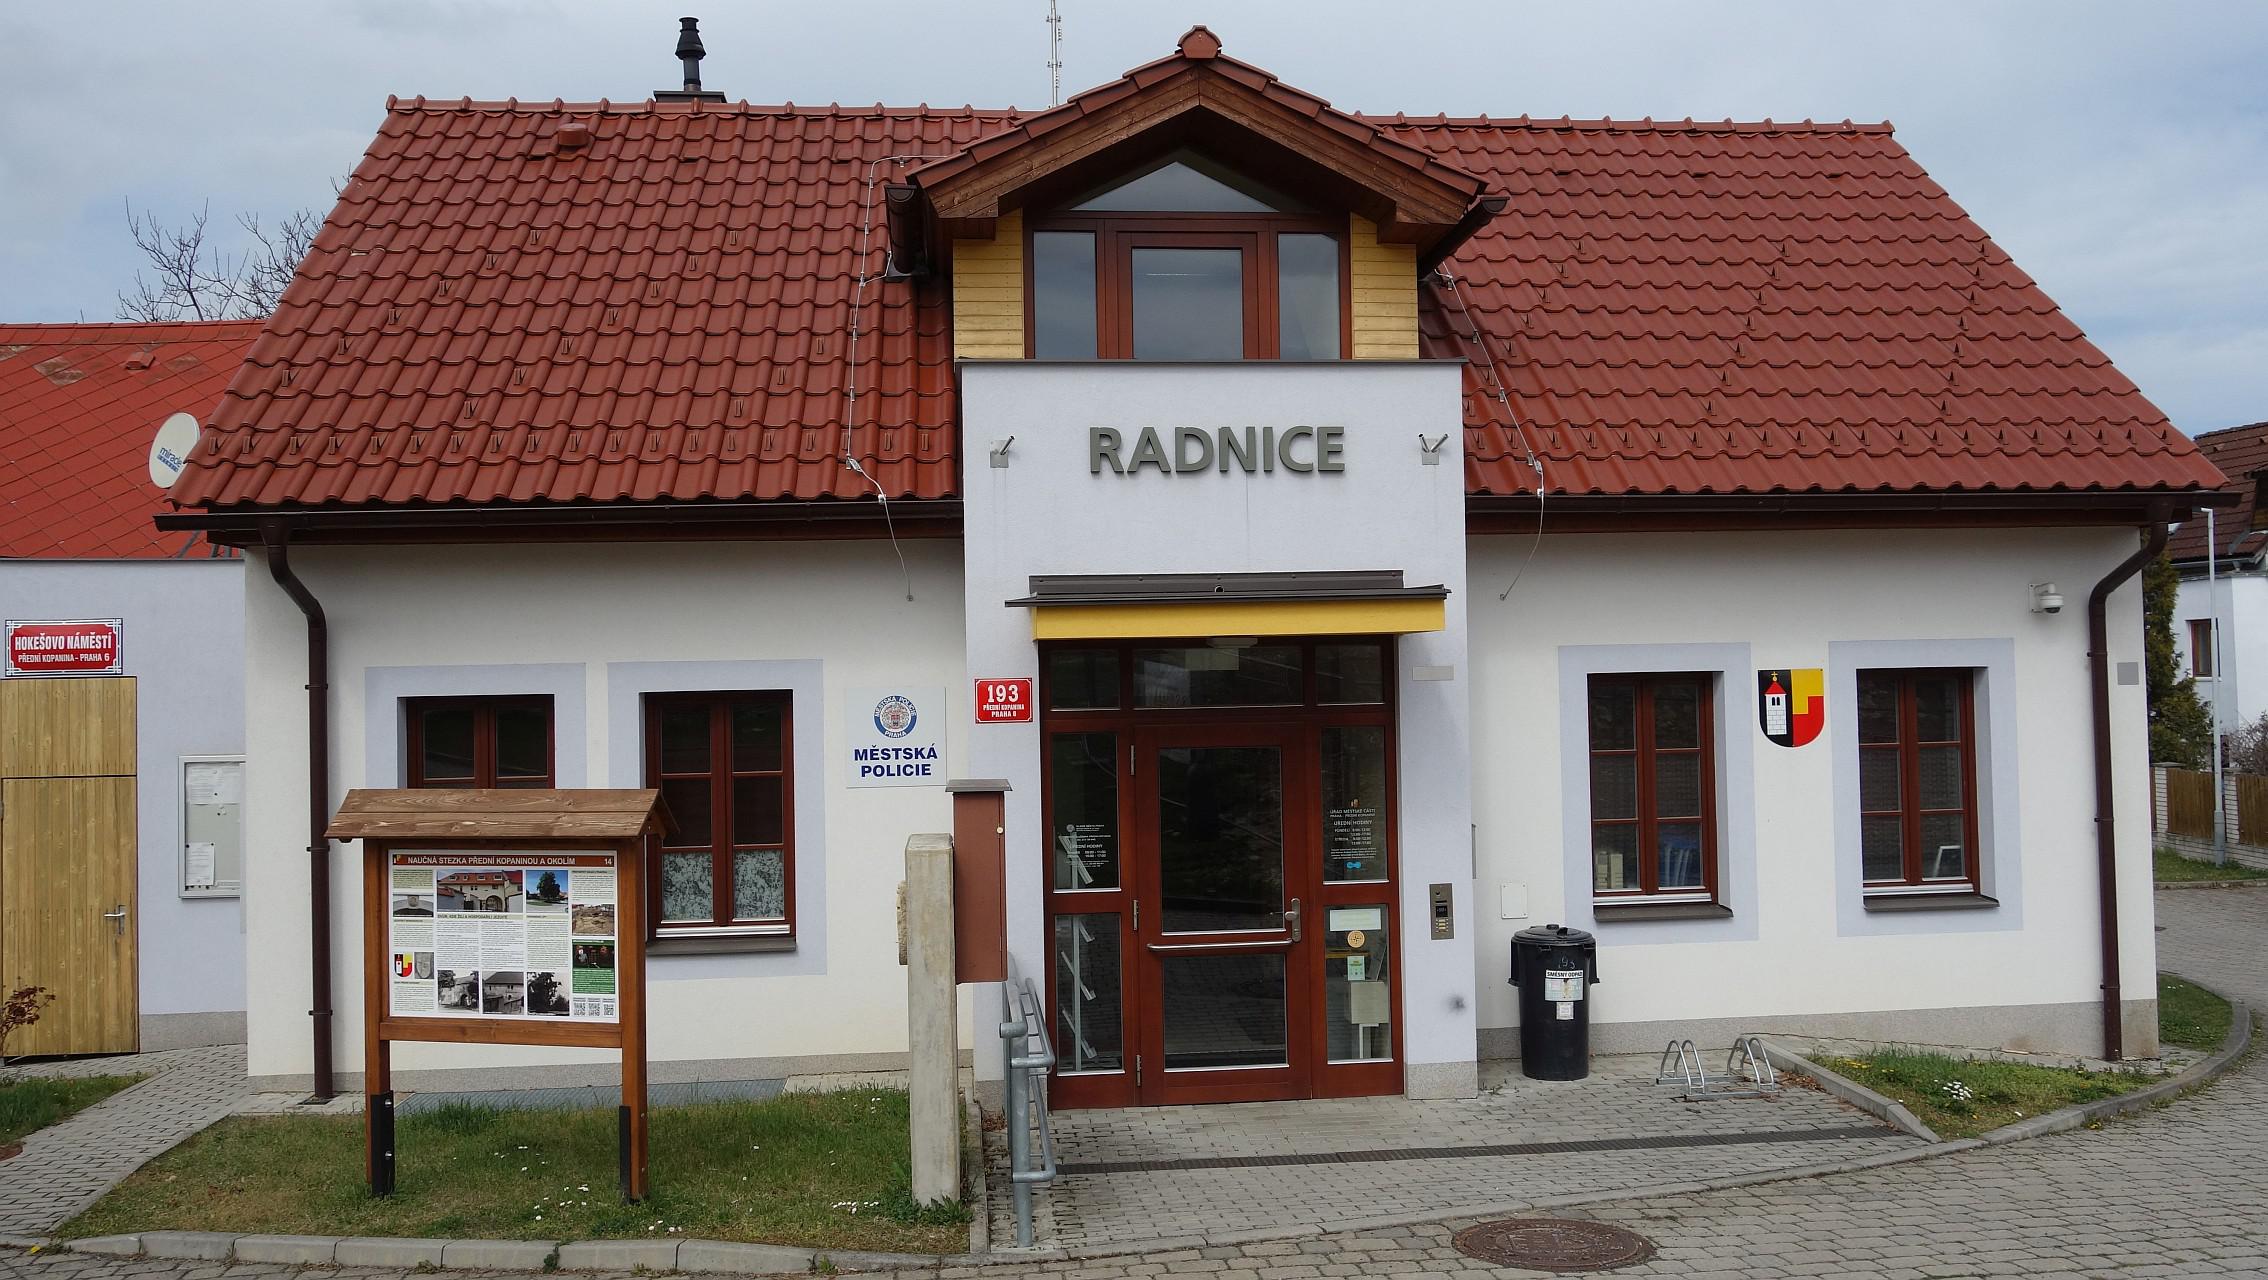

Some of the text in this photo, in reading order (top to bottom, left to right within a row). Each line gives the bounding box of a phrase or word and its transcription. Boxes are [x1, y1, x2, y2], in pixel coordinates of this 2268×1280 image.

[1089, 425, 1346, 474] RADNICE
[14, 631, 112, 651] HOKEŠOVO NÁMĚSTÍ
[18, 653, 41, 663] PŘEDNÍ
[42, 653, 74, 663] KOPANINA
[79, 652, 102, 661] PRAHA
[104, 652, 110, 661] 6
[987, 684, 1019, 703] 193
[991, 710, 1012, 718] PRAHA
[884, 730, 907, 738] PRAHA
[854, 743, 938, 761] MĚSTSKÁ
[861, 763, 932, 778] POLICIE
[407, 855, 438, 864] NAUČNÁ
[438, 856, 467, 865] STEZKA
[468, 855, 495, 865] PŘEDNÍ
[496, 857, 538, 865] KOPANINOU
[539, 857, 546, 865] A
[547, 856, 576, 865] OKOLÍM
